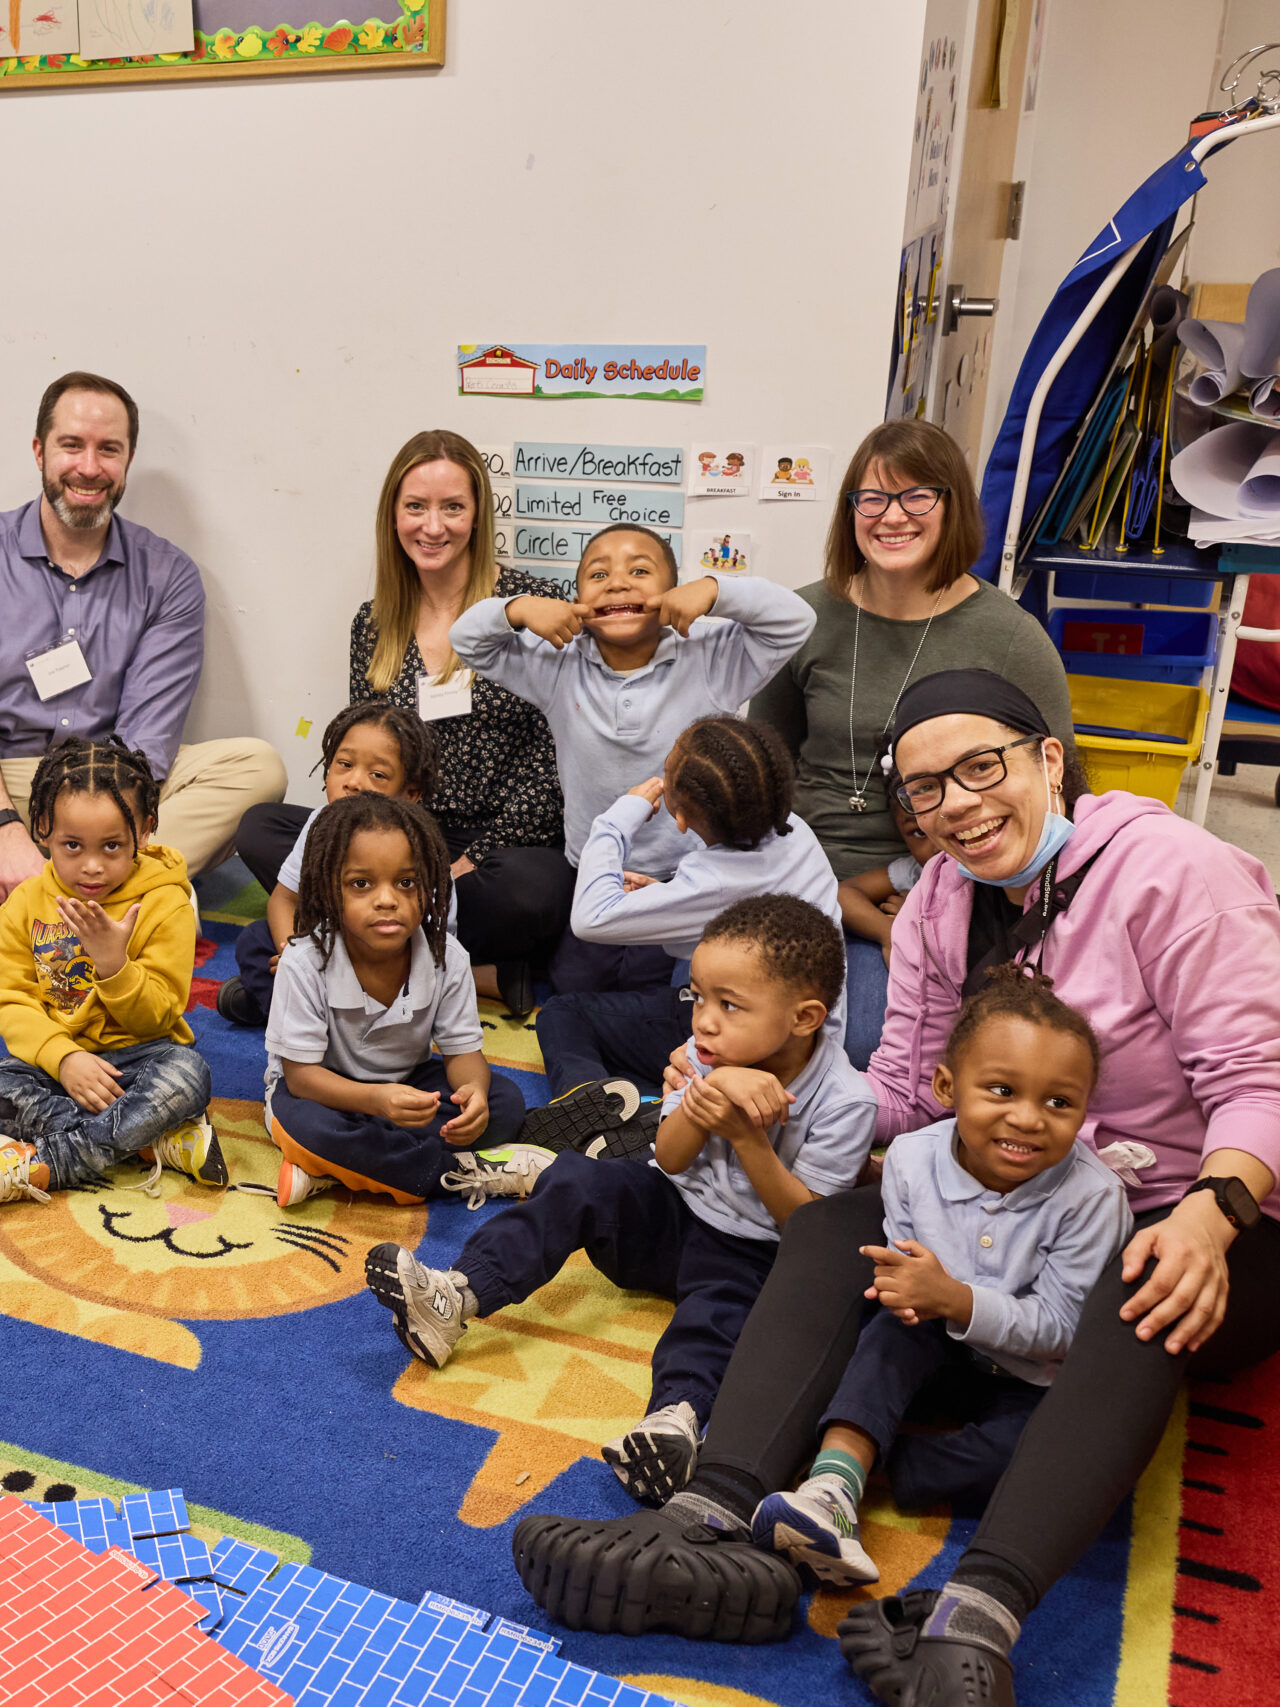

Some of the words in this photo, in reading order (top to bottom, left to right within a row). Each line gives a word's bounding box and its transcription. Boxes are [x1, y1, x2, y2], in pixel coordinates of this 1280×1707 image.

[545, 357, 597, 385] Daily
[604, 357, 701, 382] Schedule
[516, 488, 582, 516] Limited
[593, 490, 627, 506] Free
[778, 490, 793, 498] Sign
[609, 507, 670, 524] Choice
[515, 529, 568, 556] Circle
[433, 1291, 447, 1315] N
